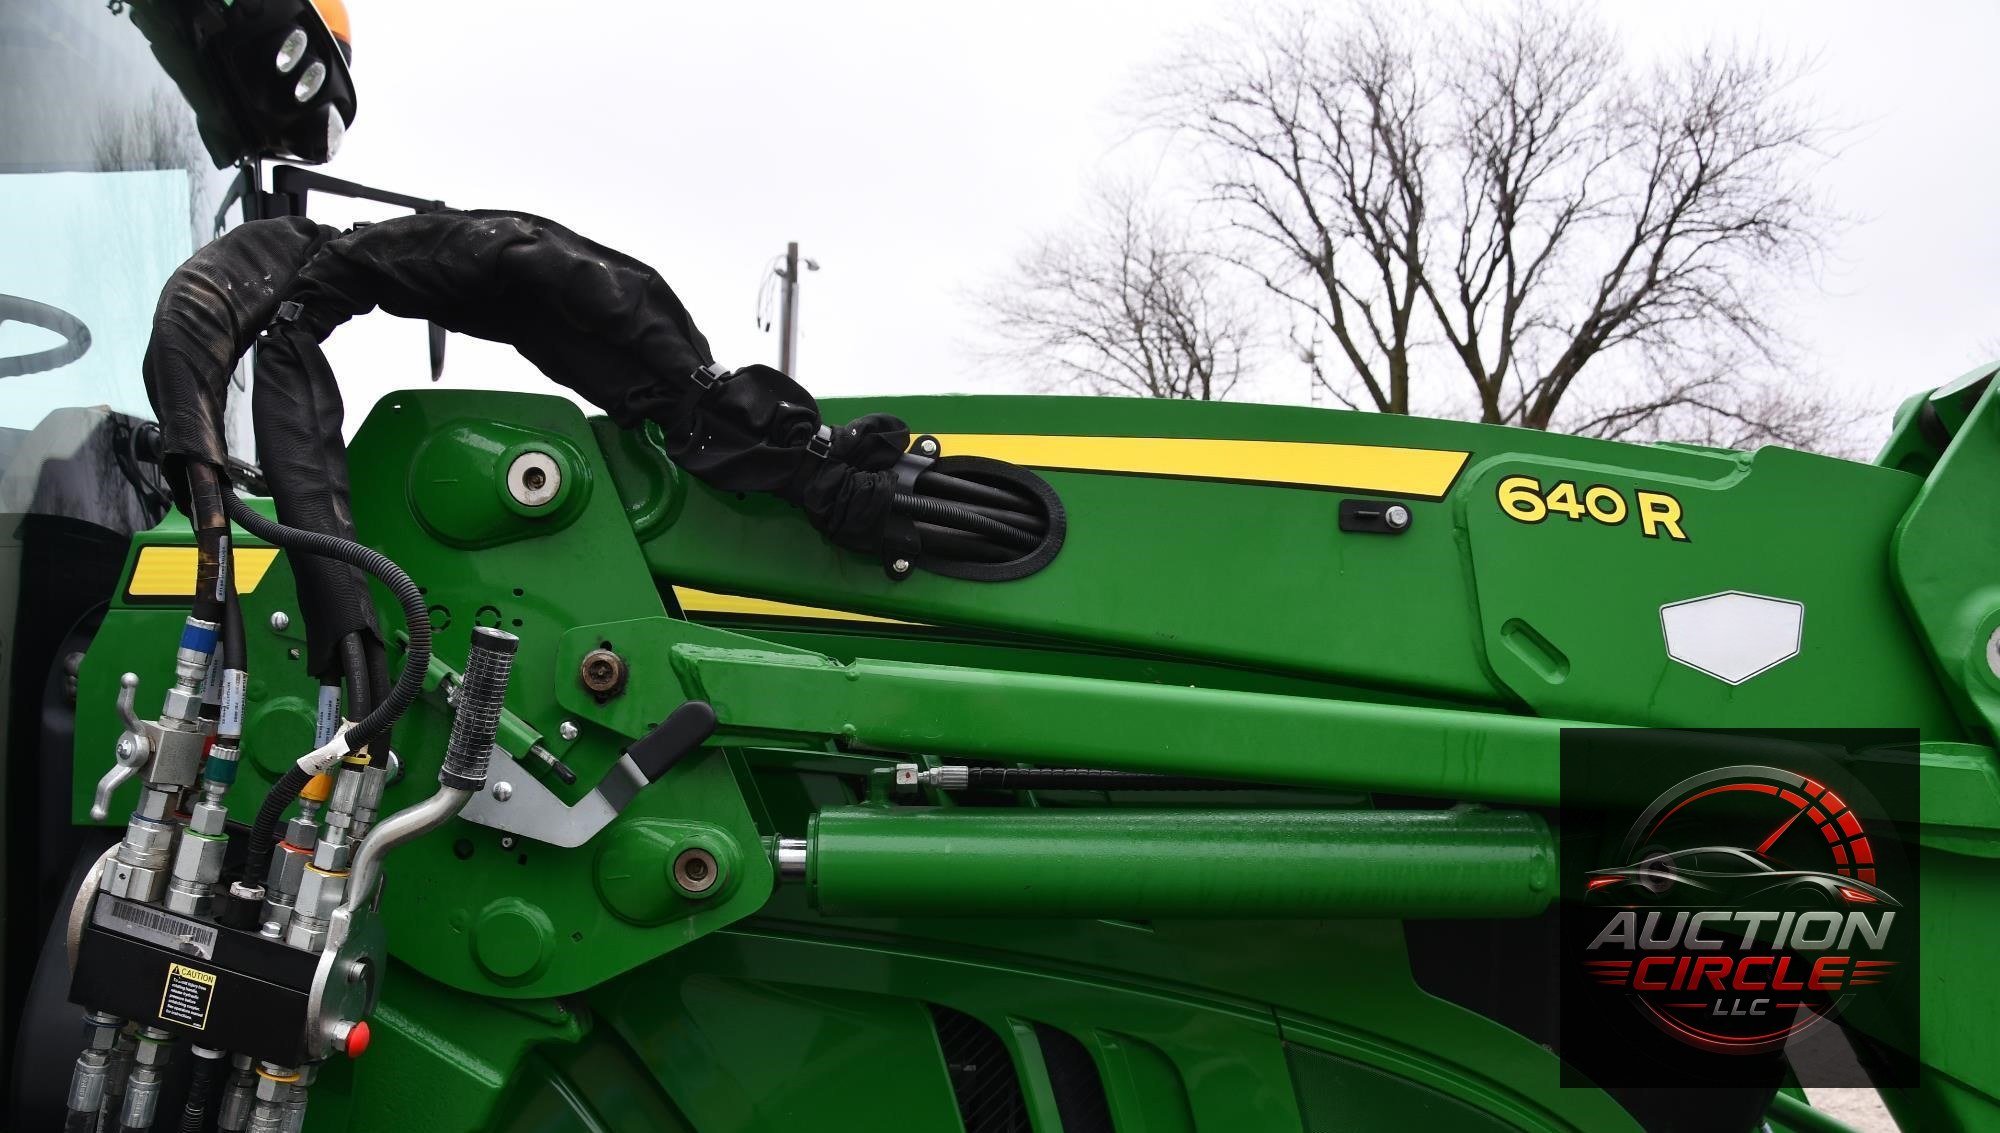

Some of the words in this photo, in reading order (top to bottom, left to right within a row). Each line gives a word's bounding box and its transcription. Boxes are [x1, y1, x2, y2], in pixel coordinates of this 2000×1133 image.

[1496, 475, 1628, 526] 640
[1634, 489, 1691, 543] R
[181, 968, 214, 983] CAUTION
